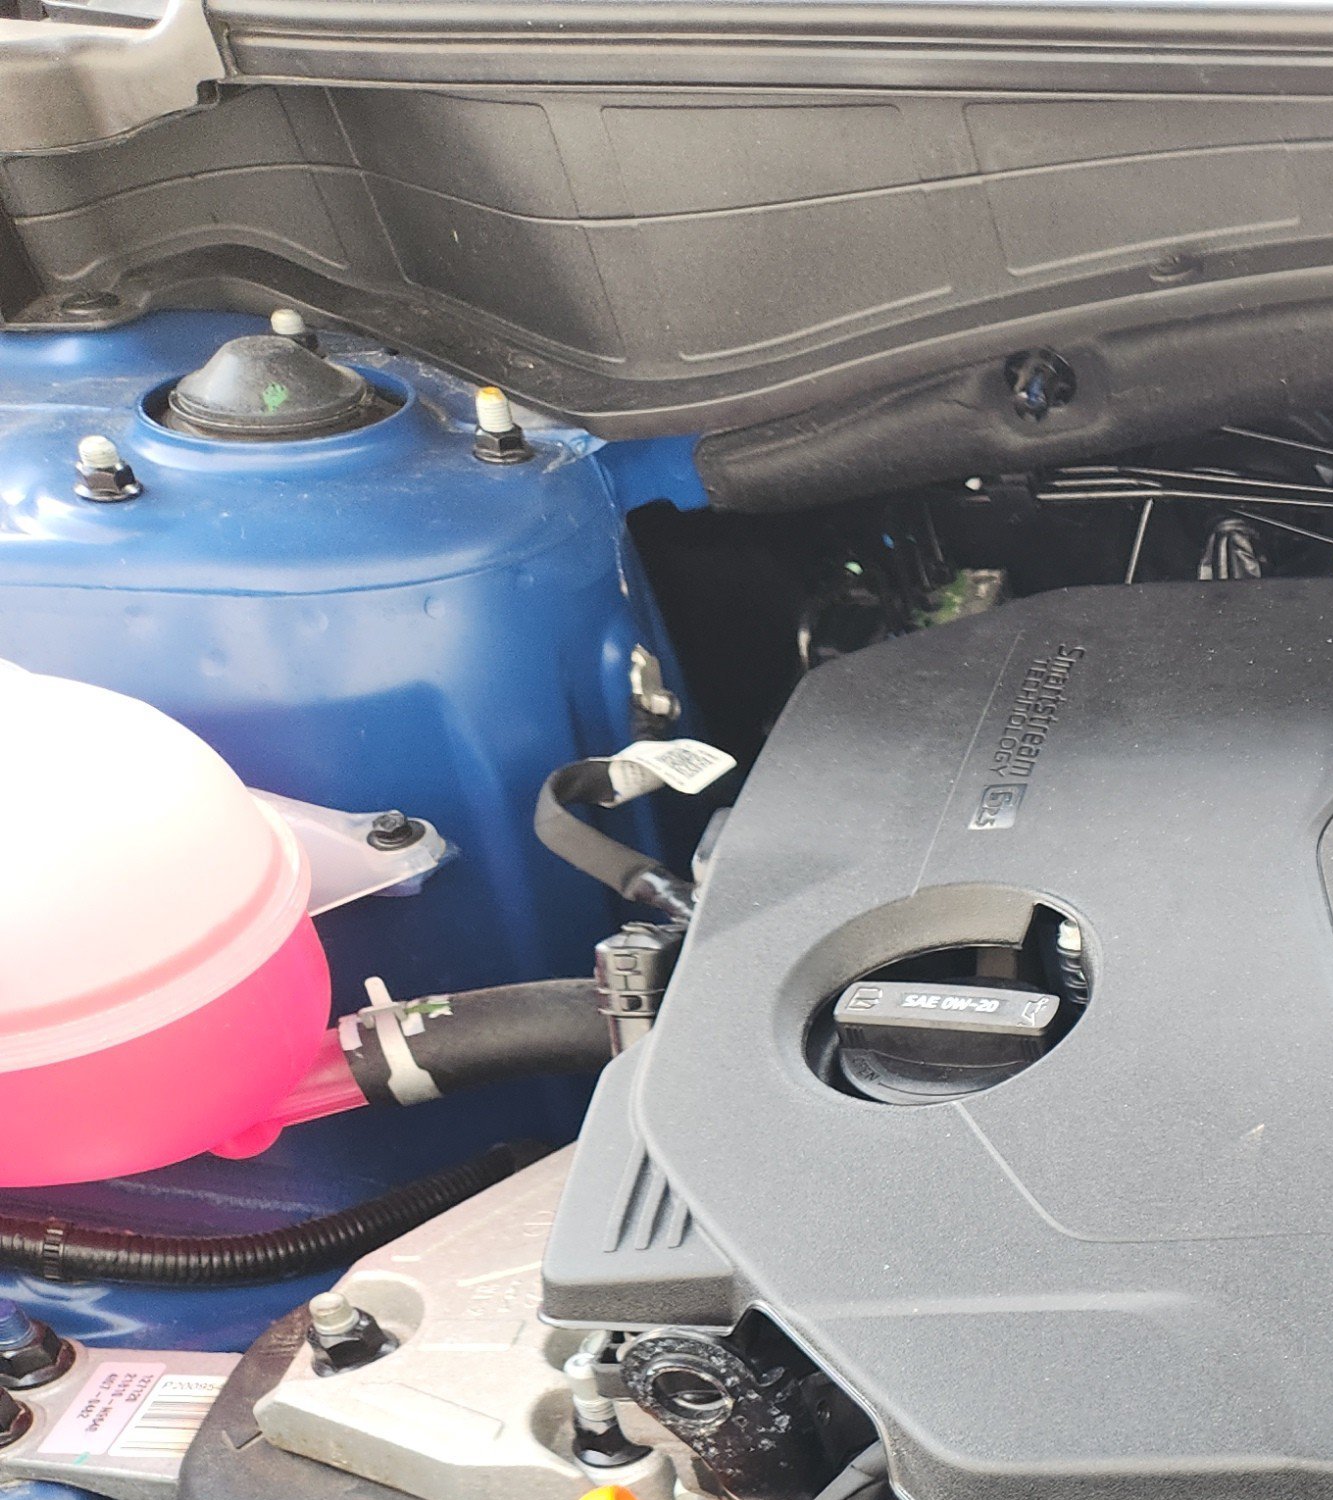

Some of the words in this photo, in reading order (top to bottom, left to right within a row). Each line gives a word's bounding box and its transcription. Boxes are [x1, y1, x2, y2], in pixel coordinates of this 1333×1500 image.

[990, 659, 1048, 777] TECHNOLOGY
[1010, 643, 1086, 777] Smartstream
[901, 994, 939, 1009] SAE
[941, 996, 1000, 1013] 0W-20
